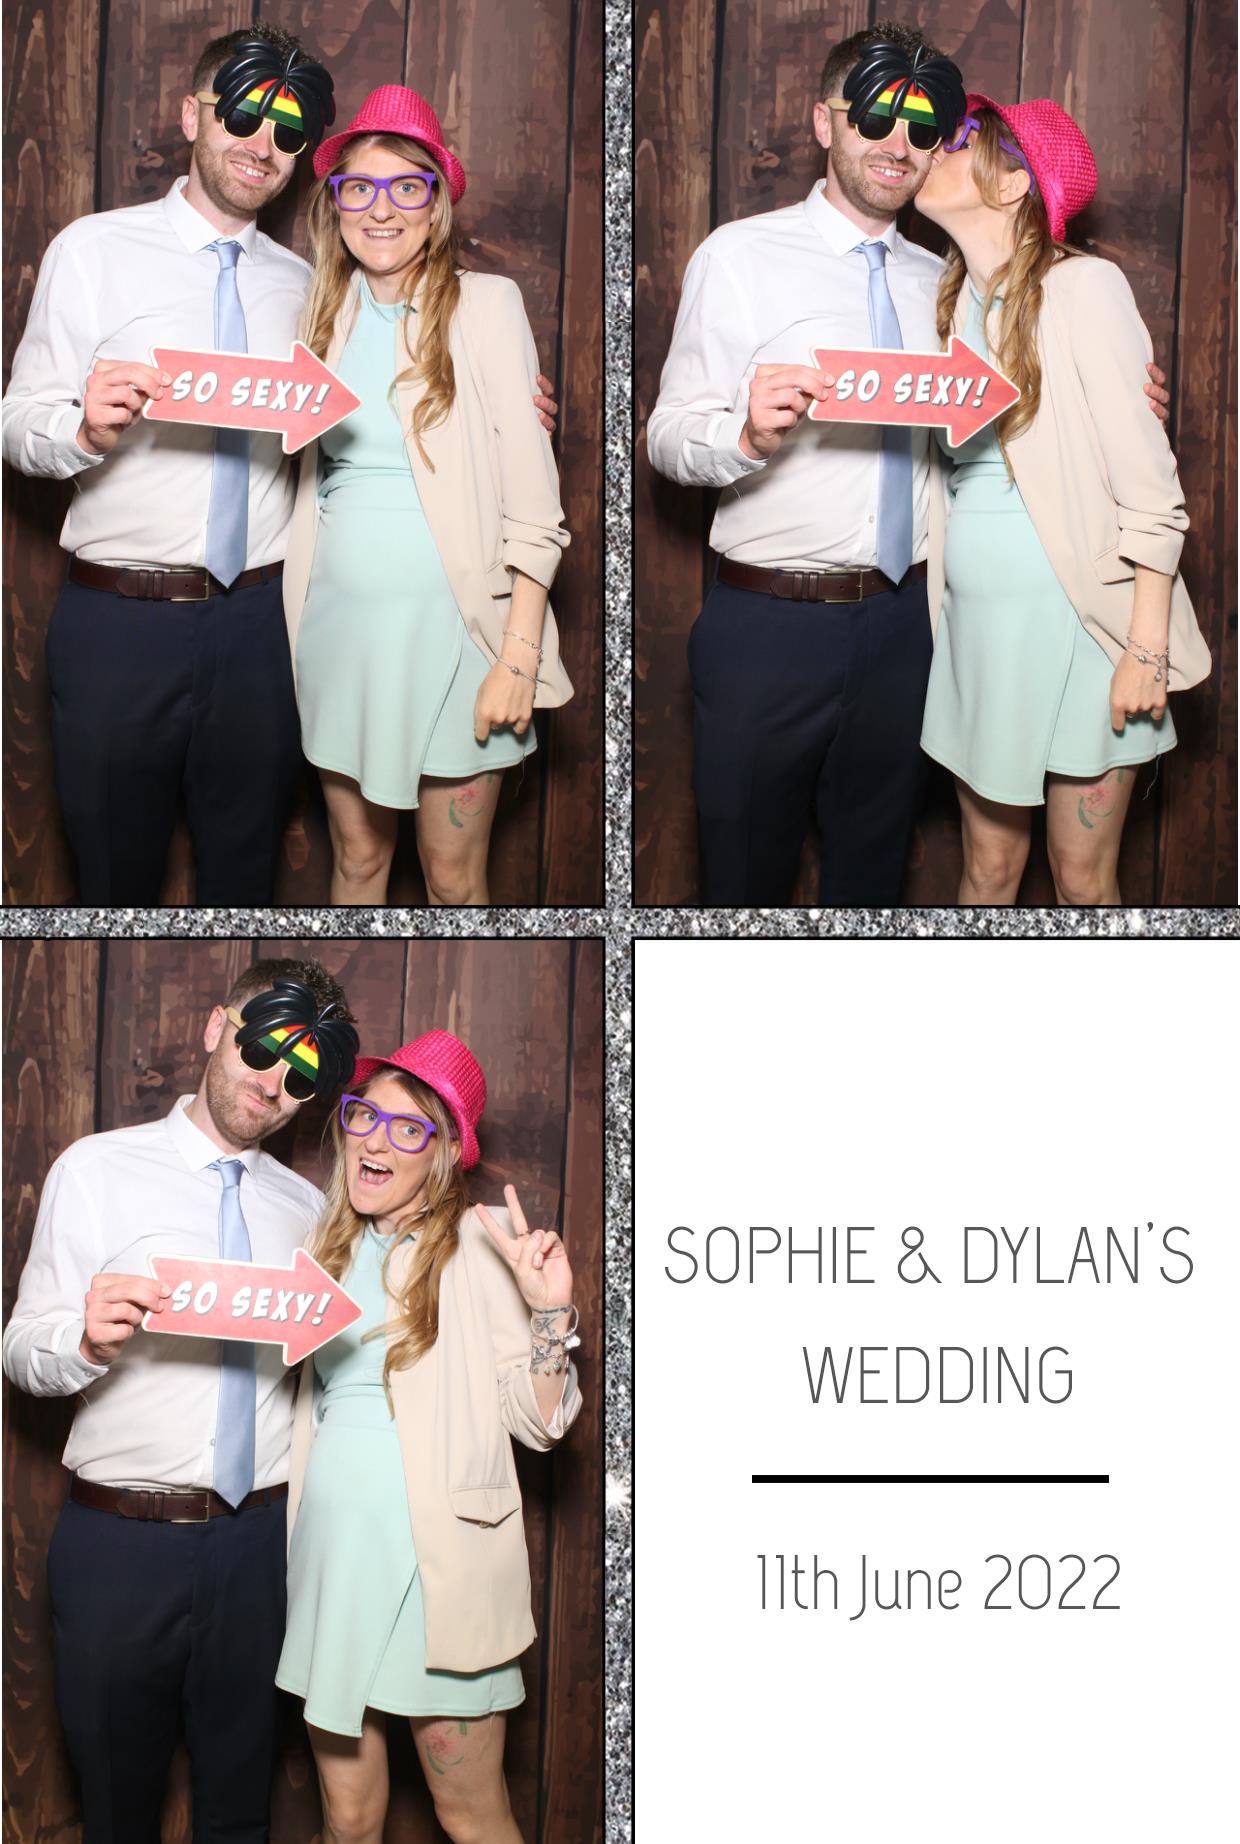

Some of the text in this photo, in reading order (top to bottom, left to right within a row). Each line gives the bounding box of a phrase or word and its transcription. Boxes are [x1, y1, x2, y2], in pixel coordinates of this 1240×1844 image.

[172, 370, 332, 414] SO SEXY!
[835, 369, 990, 407] SO SEXY!
[171, 1280, 333, 1325] SO SEXY!
